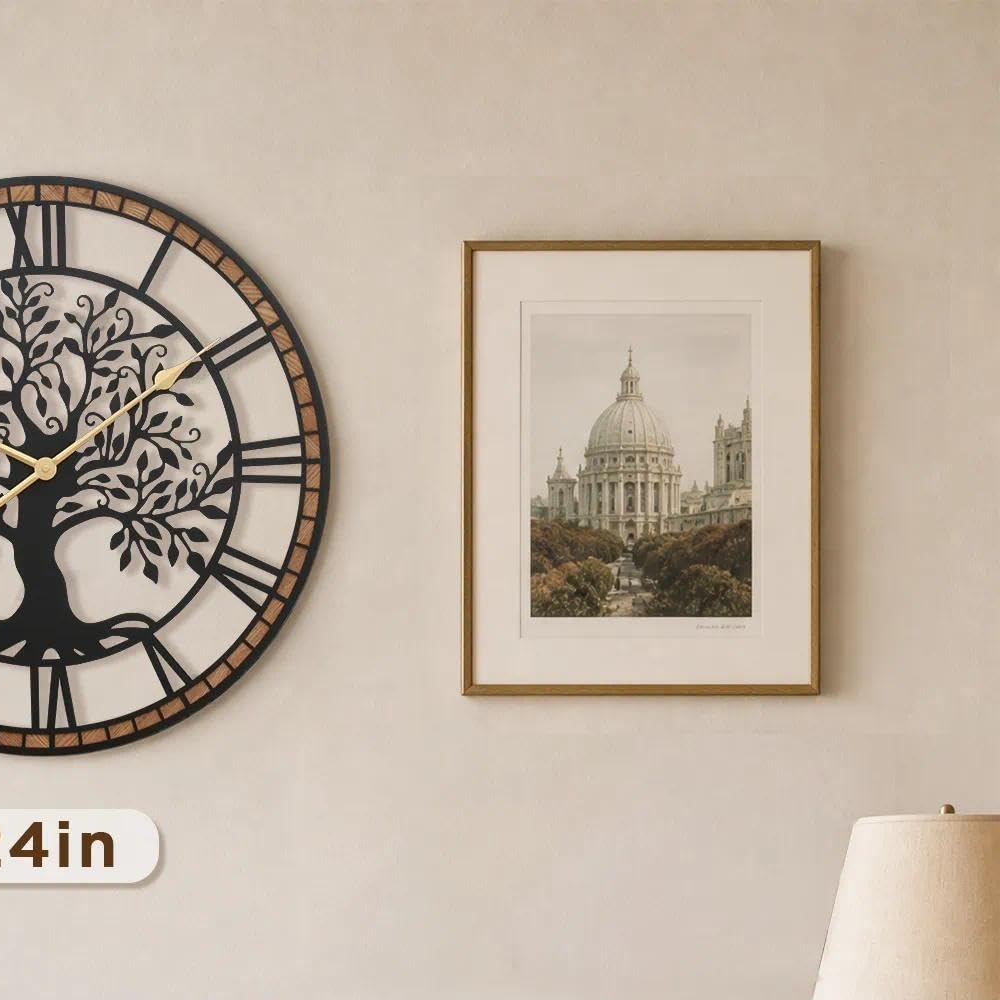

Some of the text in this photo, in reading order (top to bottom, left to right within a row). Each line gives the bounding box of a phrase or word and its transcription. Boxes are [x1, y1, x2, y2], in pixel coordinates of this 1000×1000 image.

[5, 204, 66, 268] XII
[206, 319, 271, 372] II
[240, 435, 302, 484] III
[142, 633, 193, 697] V
